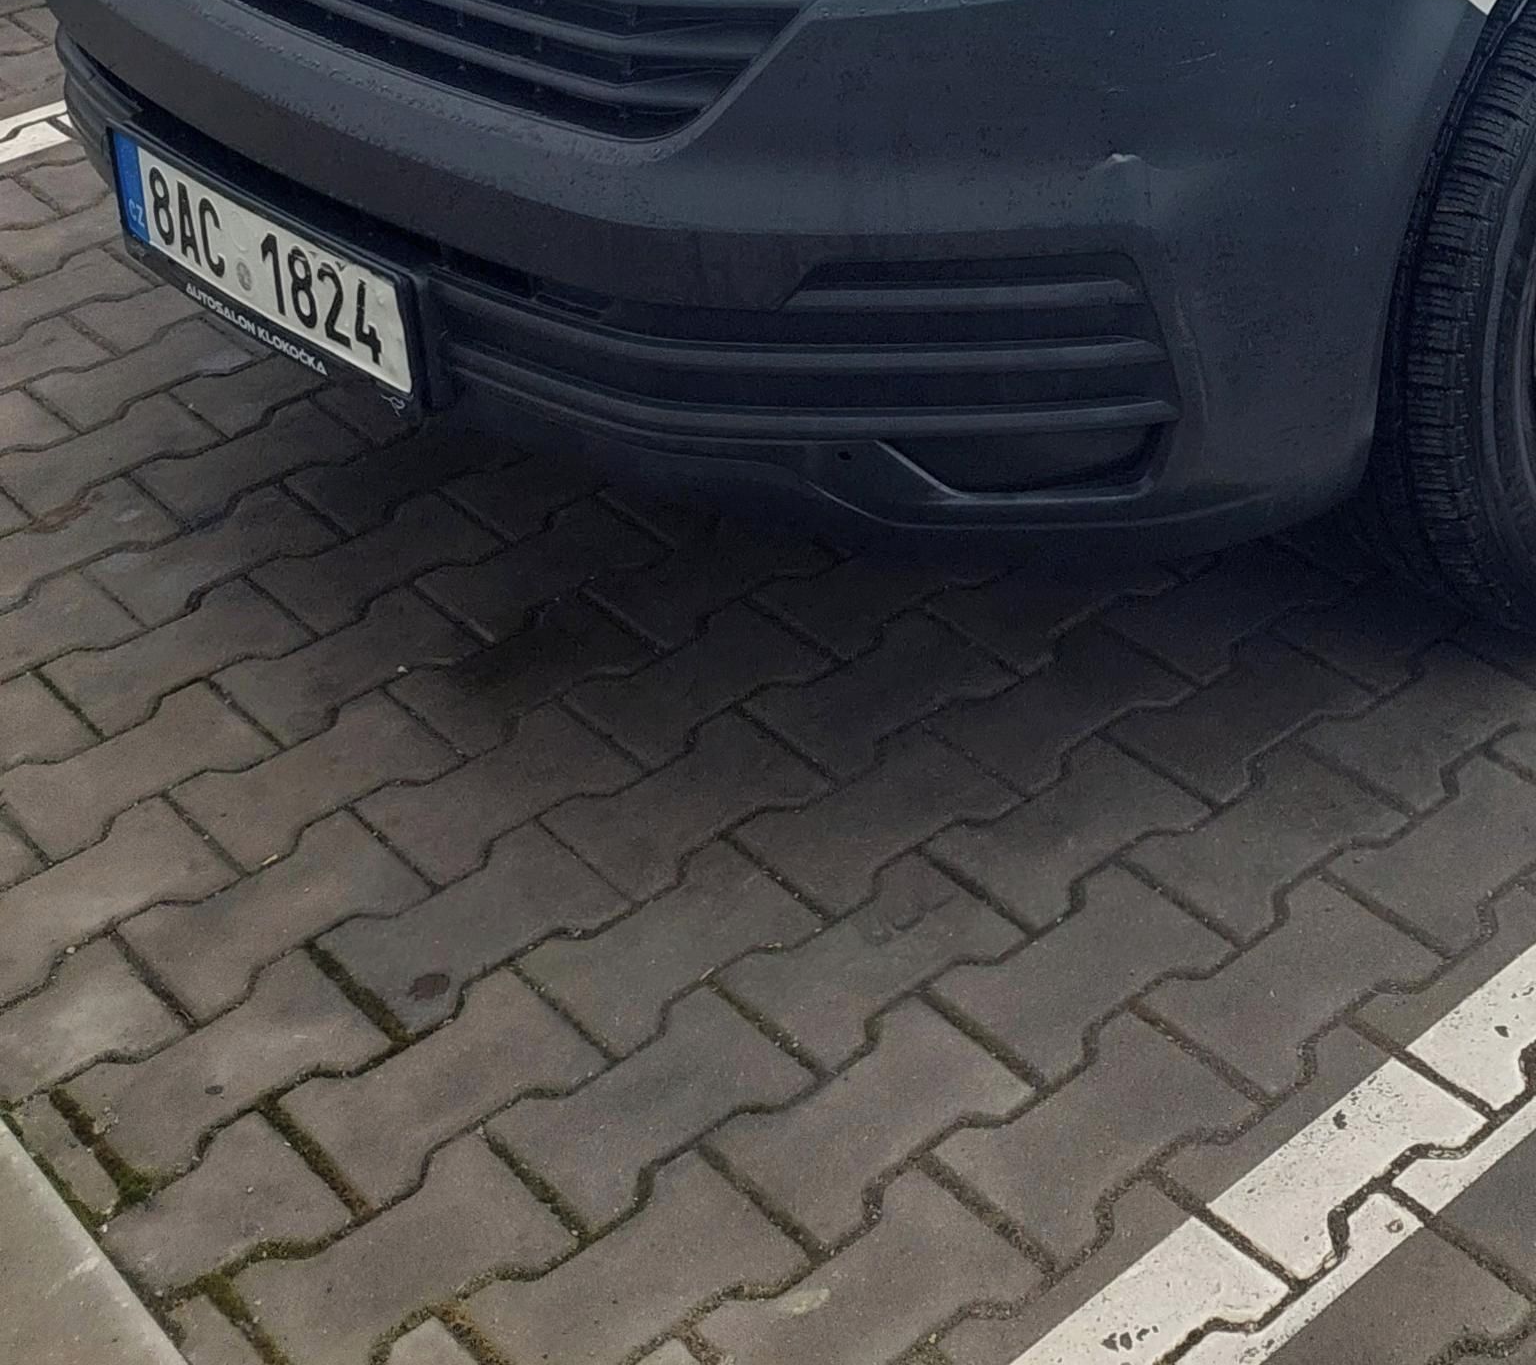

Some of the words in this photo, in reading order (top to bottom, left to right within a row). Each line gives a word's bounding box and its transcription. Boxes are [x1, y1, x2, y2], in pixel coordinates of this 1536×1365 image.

[127, 197, 146, 228] CZ
[148, 165, 226, 279] 8AC
[260, 232, 384, 368] 1824
[185, 282, 257, 336] AUTOSALON
[257, 325, 329, 377] KLOKOČKA
